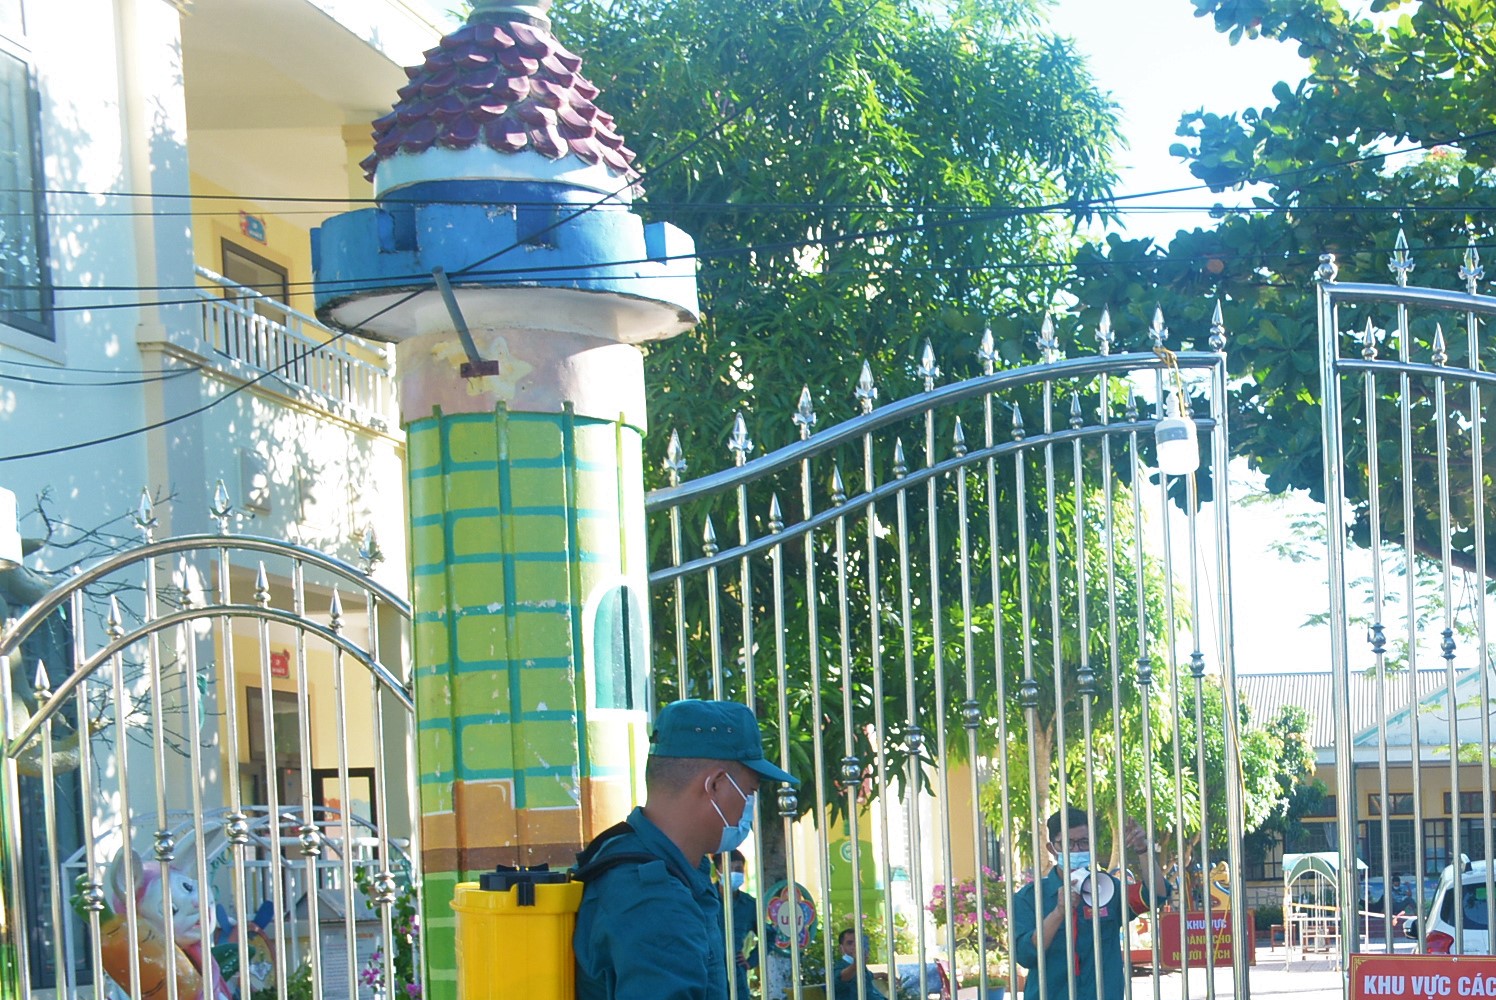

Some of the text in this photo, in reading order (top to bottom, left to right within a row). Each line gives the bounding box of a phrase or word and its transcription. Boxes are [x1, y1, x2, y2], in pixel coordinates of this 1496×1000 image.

[1187, 920, 1206, 929] KHU
[1364, 975, 1405, 995] KHU
[1411, 974, 1451, 1000] VỰC
